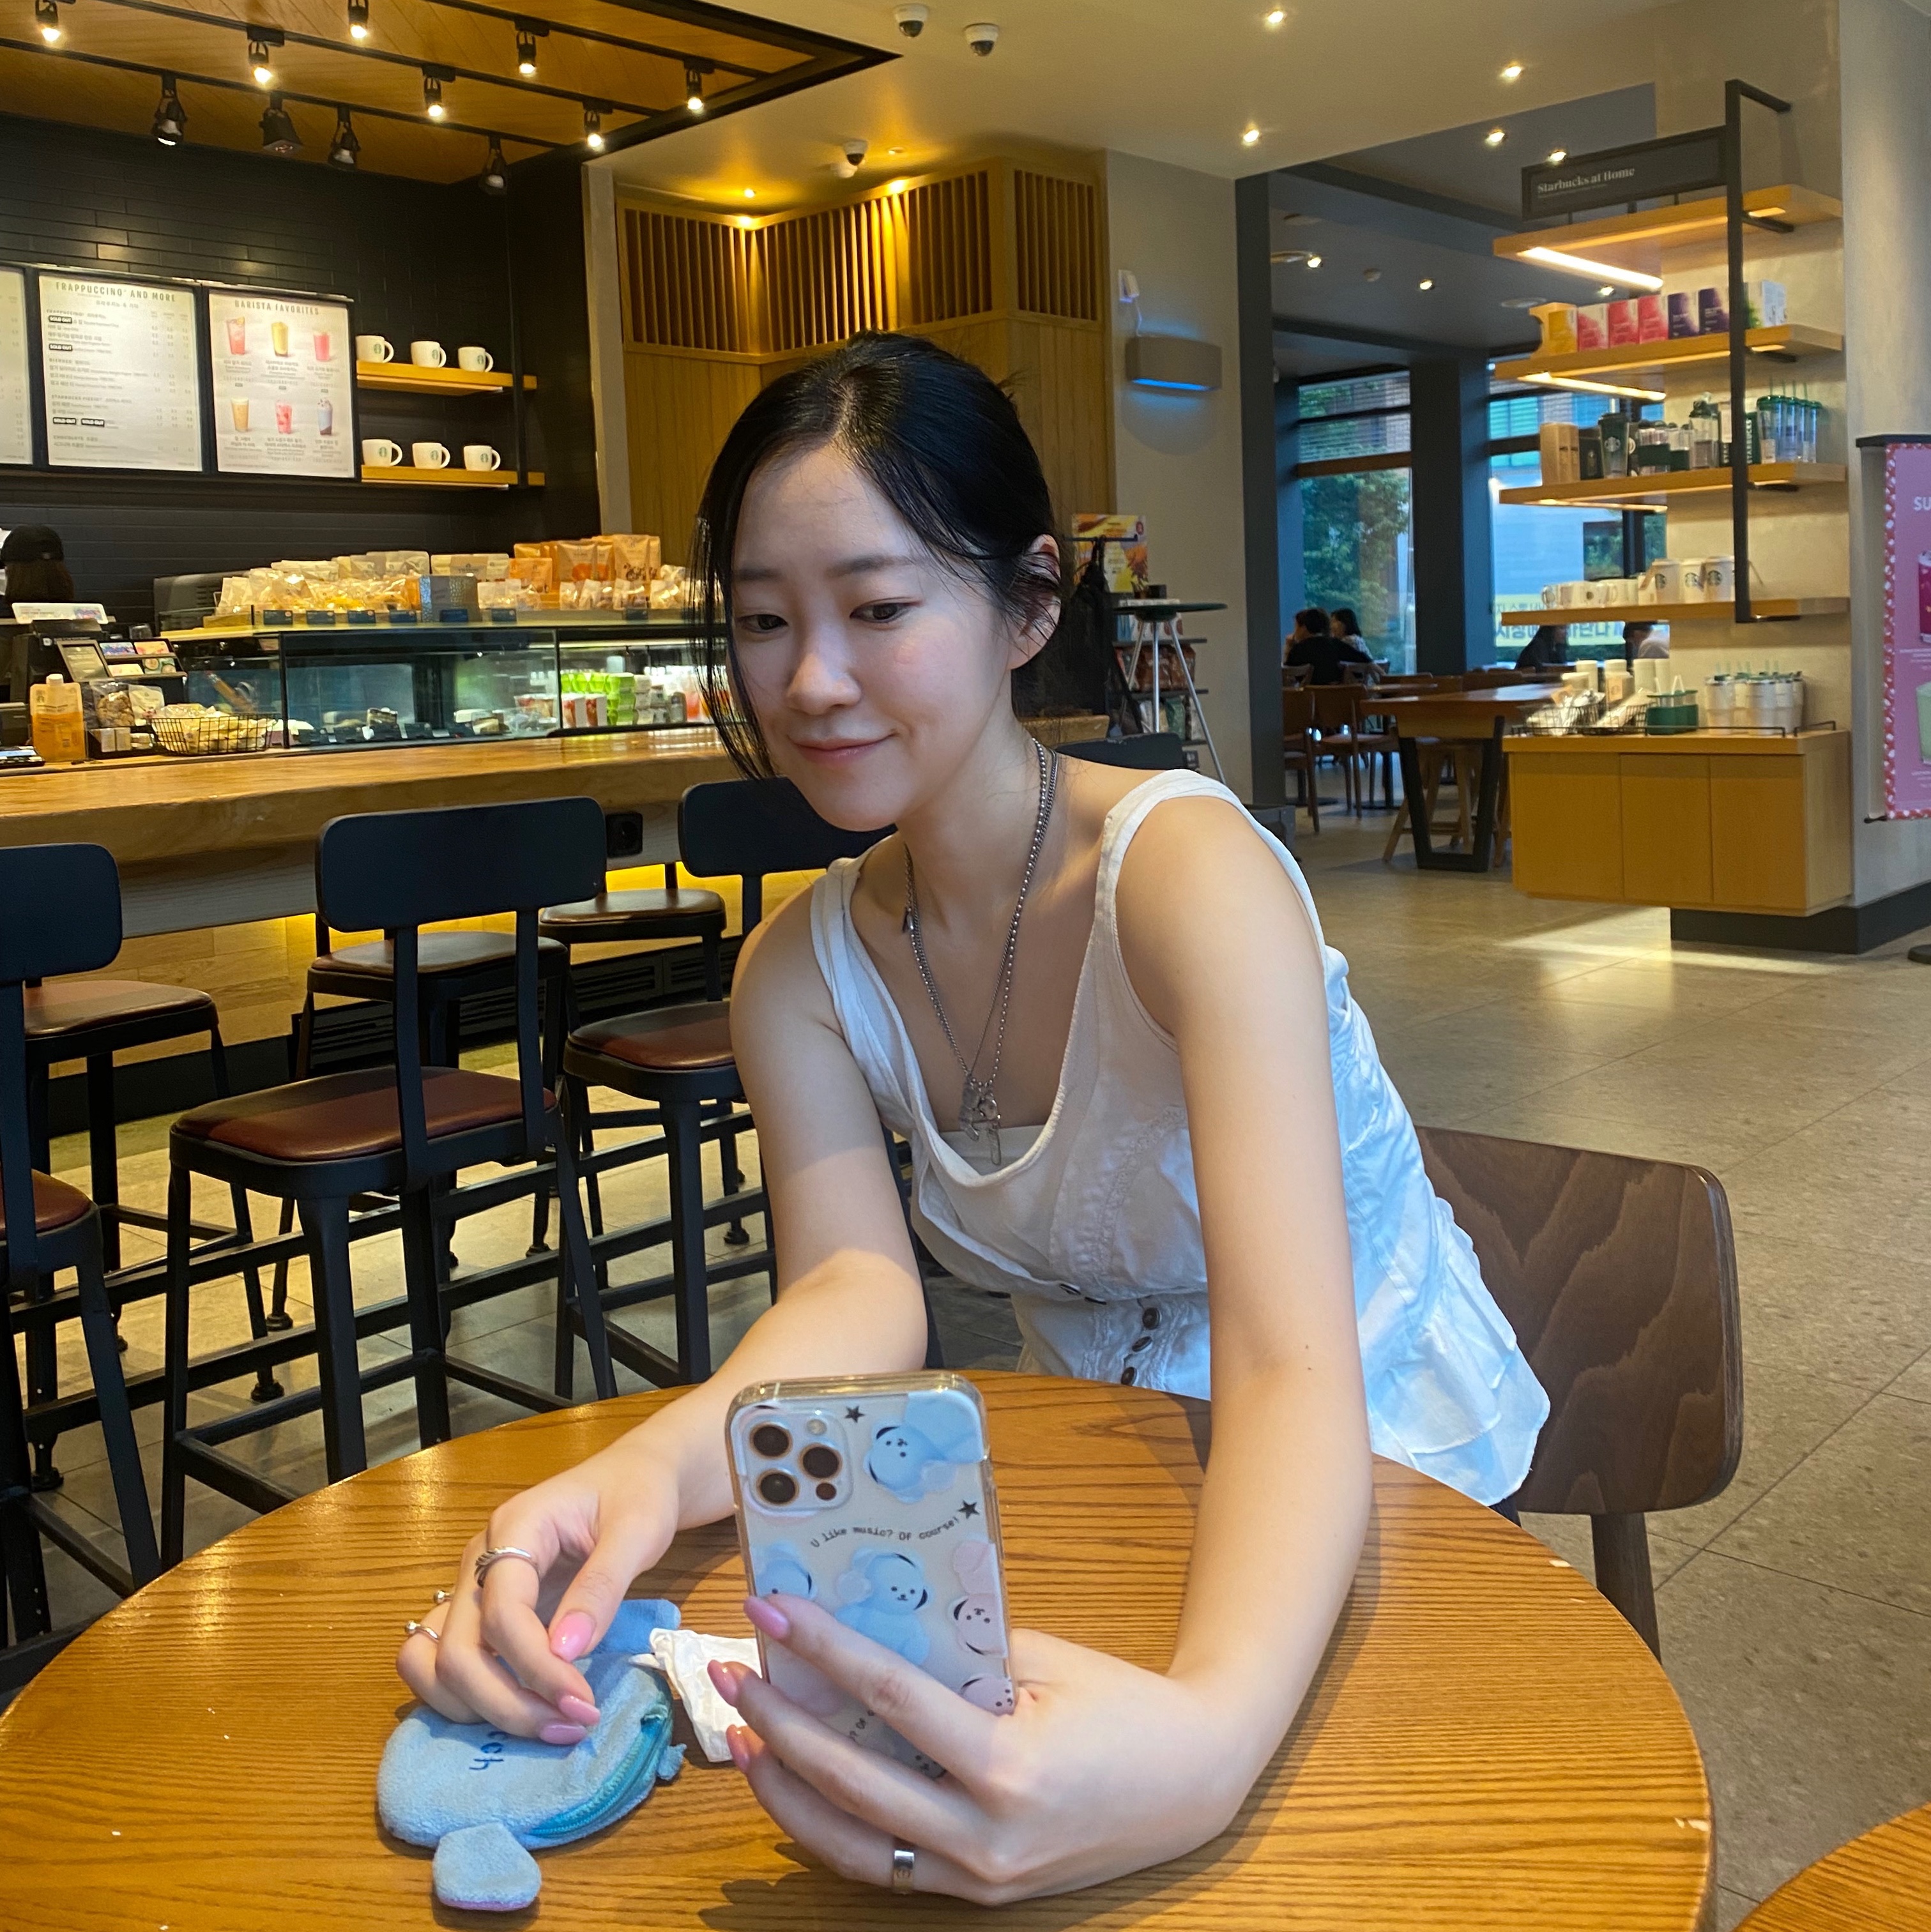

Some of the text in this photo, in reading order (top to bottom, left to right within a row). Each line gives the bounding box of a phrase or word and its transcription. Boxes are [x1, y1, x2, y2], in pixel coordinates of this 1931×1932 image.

[1538, 176, 1589, 193] Starbucks
[1591, 174, 1601, 183] at
[1604, 168, 1635, 181] Home
[130, 291, 148, 300] AND
[152, 293, 176, 302] MORE
[234, 300, 319, 315] BARISTA FAVORITES
[810, 1516, 961, 1548] U like music? Of course!
